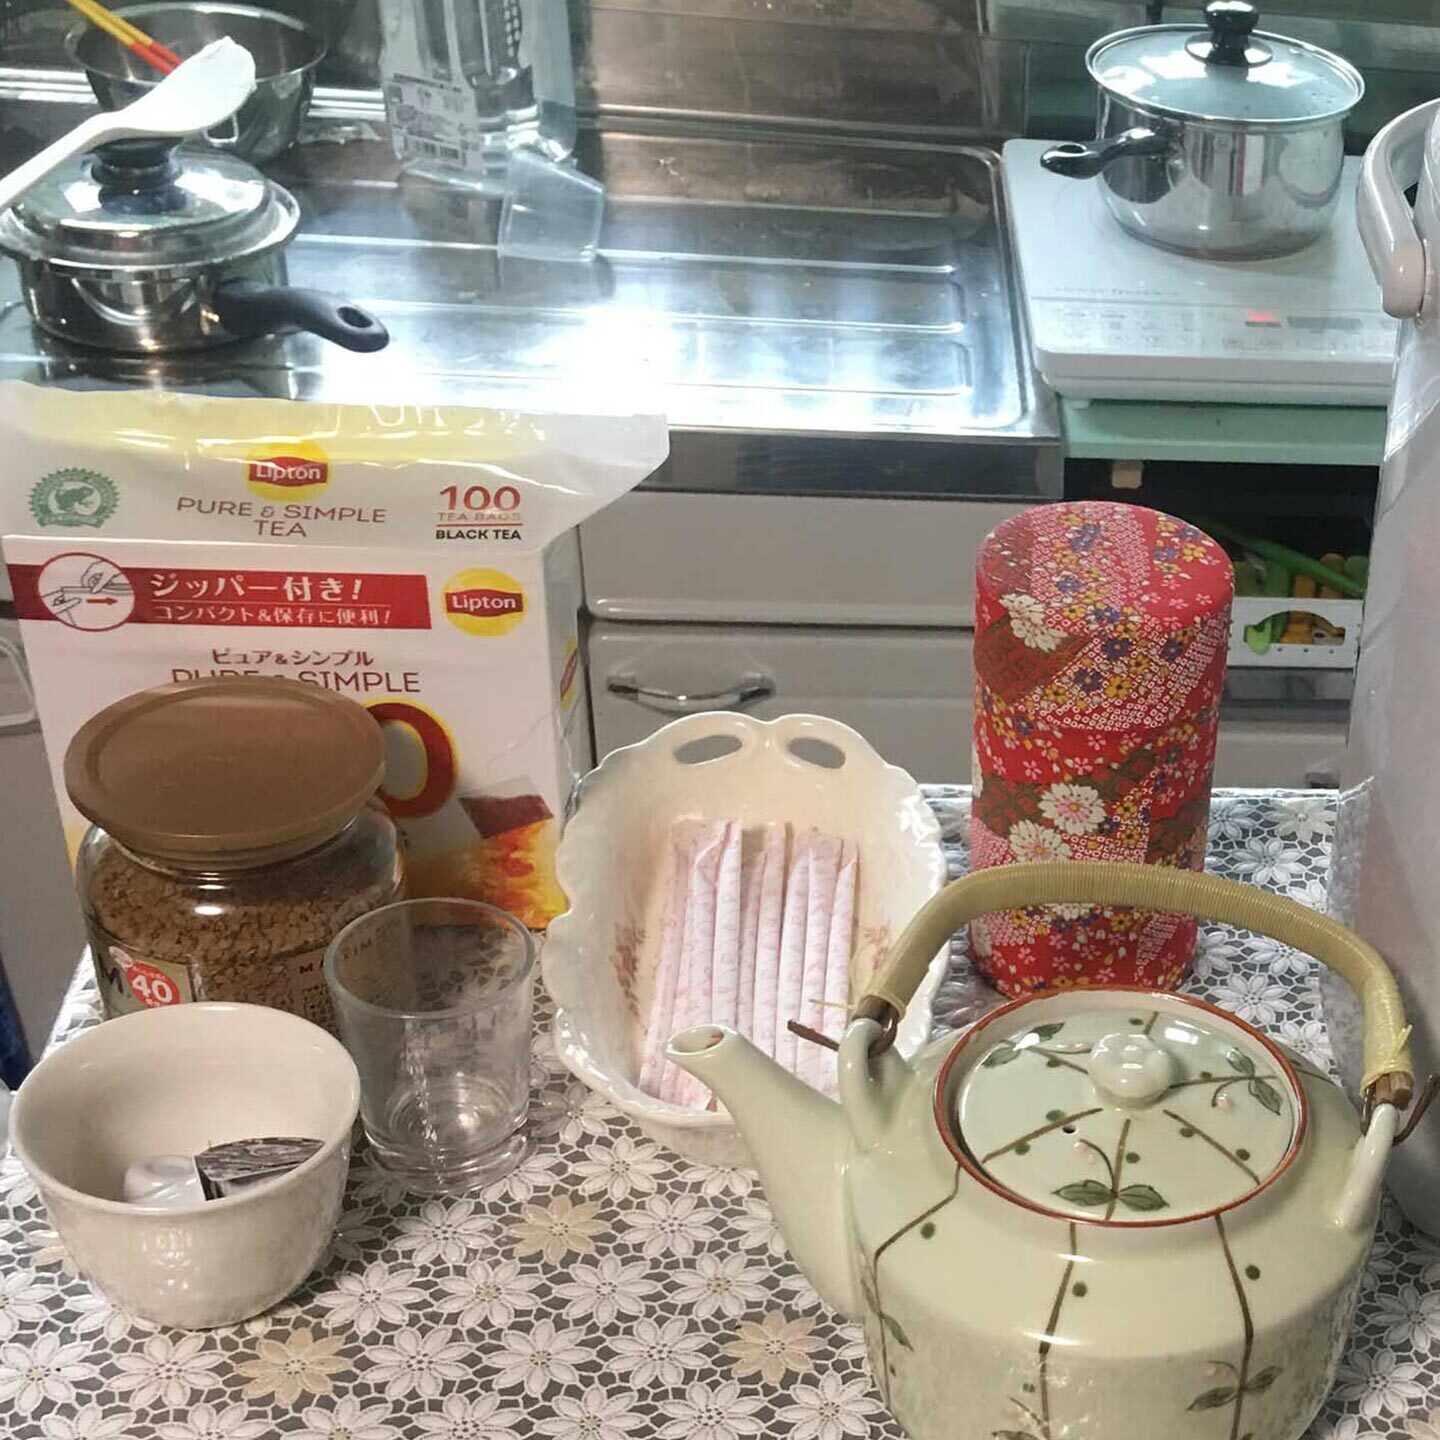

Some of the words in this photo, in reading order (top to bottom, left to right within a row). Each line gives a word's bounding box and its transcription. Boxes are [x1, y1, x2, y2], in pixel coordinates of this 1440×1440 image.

[256, 463, 321, 481] Lipton
[440, 485, 521, 511] 100
[177, 497, 253, 516] PURE
[284, 504, 387, 523] SIMPLE
[438, 512, 467, 522] TEA
[254, 520, 307, 537] TEA
[436, 529, 488, 540] BLACK
[493, 529, 522, 540] TEA
[452, 595, 516, 611] Lipton
[132, 974, 173, 1003] 40
